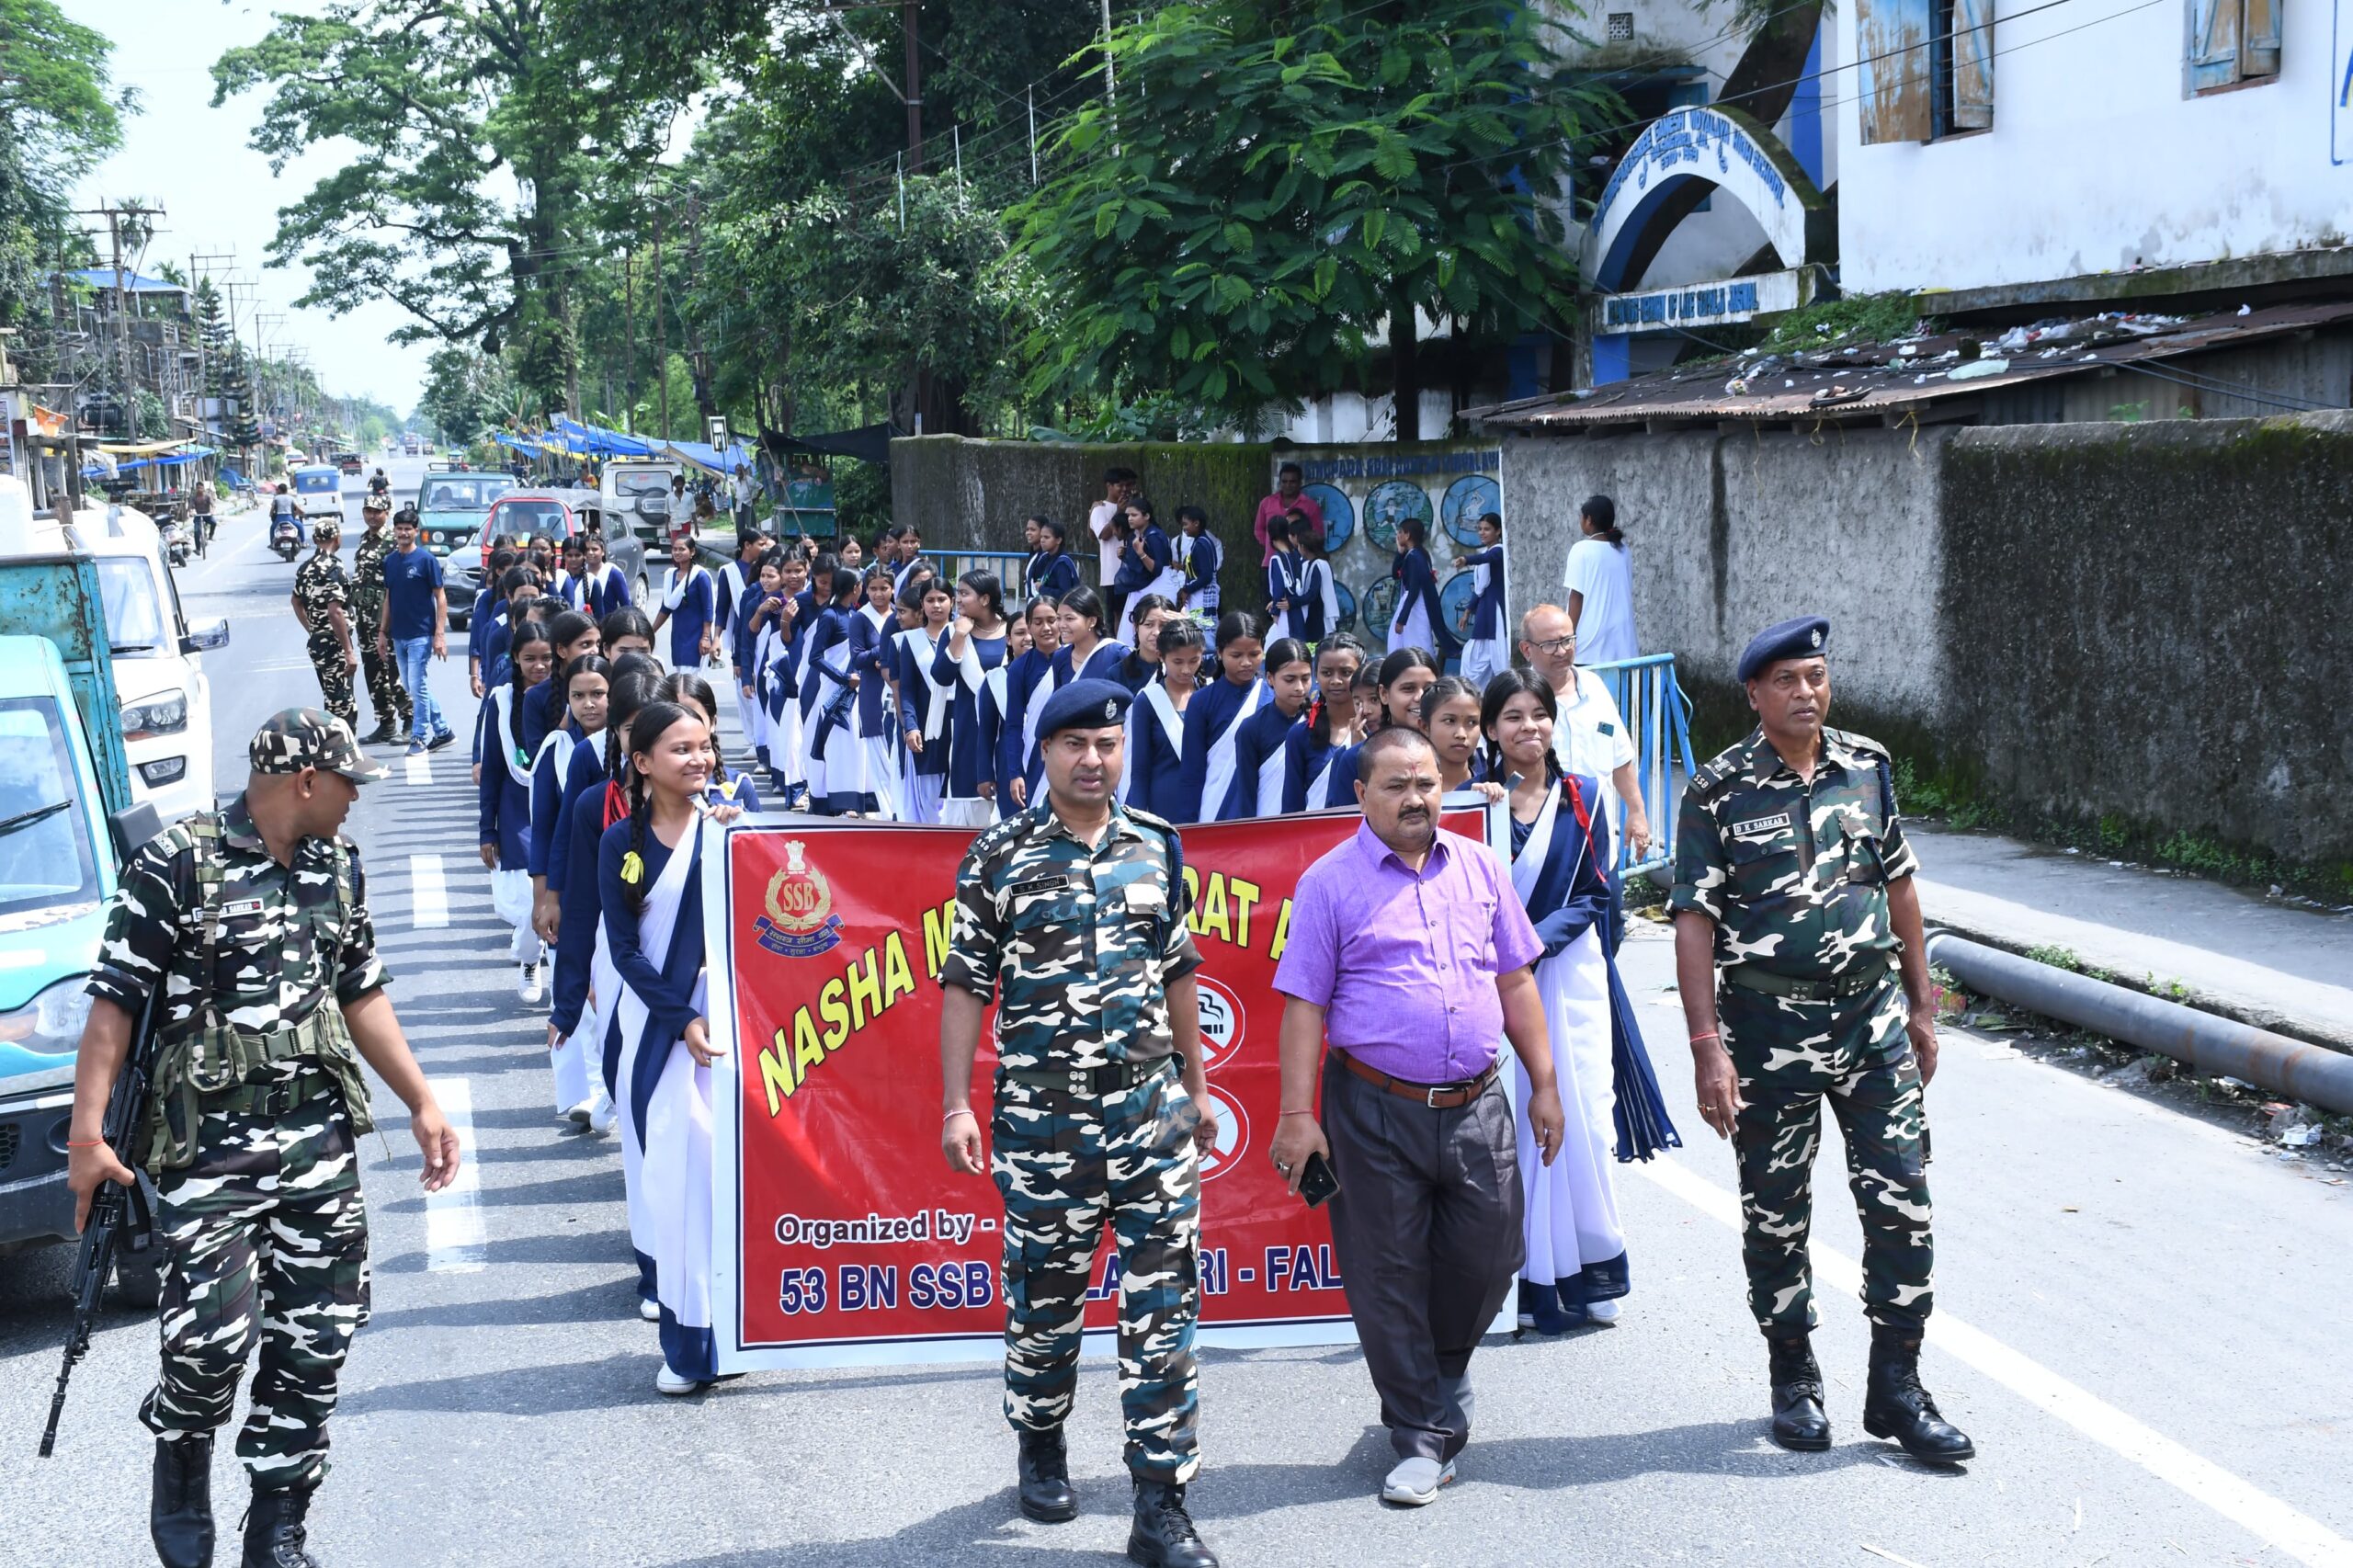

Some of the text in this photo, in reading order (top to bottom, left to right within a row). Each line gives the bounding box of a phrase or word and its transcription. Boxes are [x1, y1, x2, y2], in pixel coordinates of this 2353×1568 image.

[1693, 774, 1709, 789] SSB
[1753, 817, 1783, 830] SARKAR
[783, 882, 814, 911] SSB
[1036, 880, 1060, 890] SINGH
[758, 930, 916, 1119] NASHA
[776, 1211, 928, 1248] Organized
[936, 1210, 974, 1244] by
[780, 1267, 826, 1314] 53
[839, 1265, 897, 1311] BN
[909, 1261, 993, 1309] SSB
[1265, 1244, 1343, 1292] FAL
